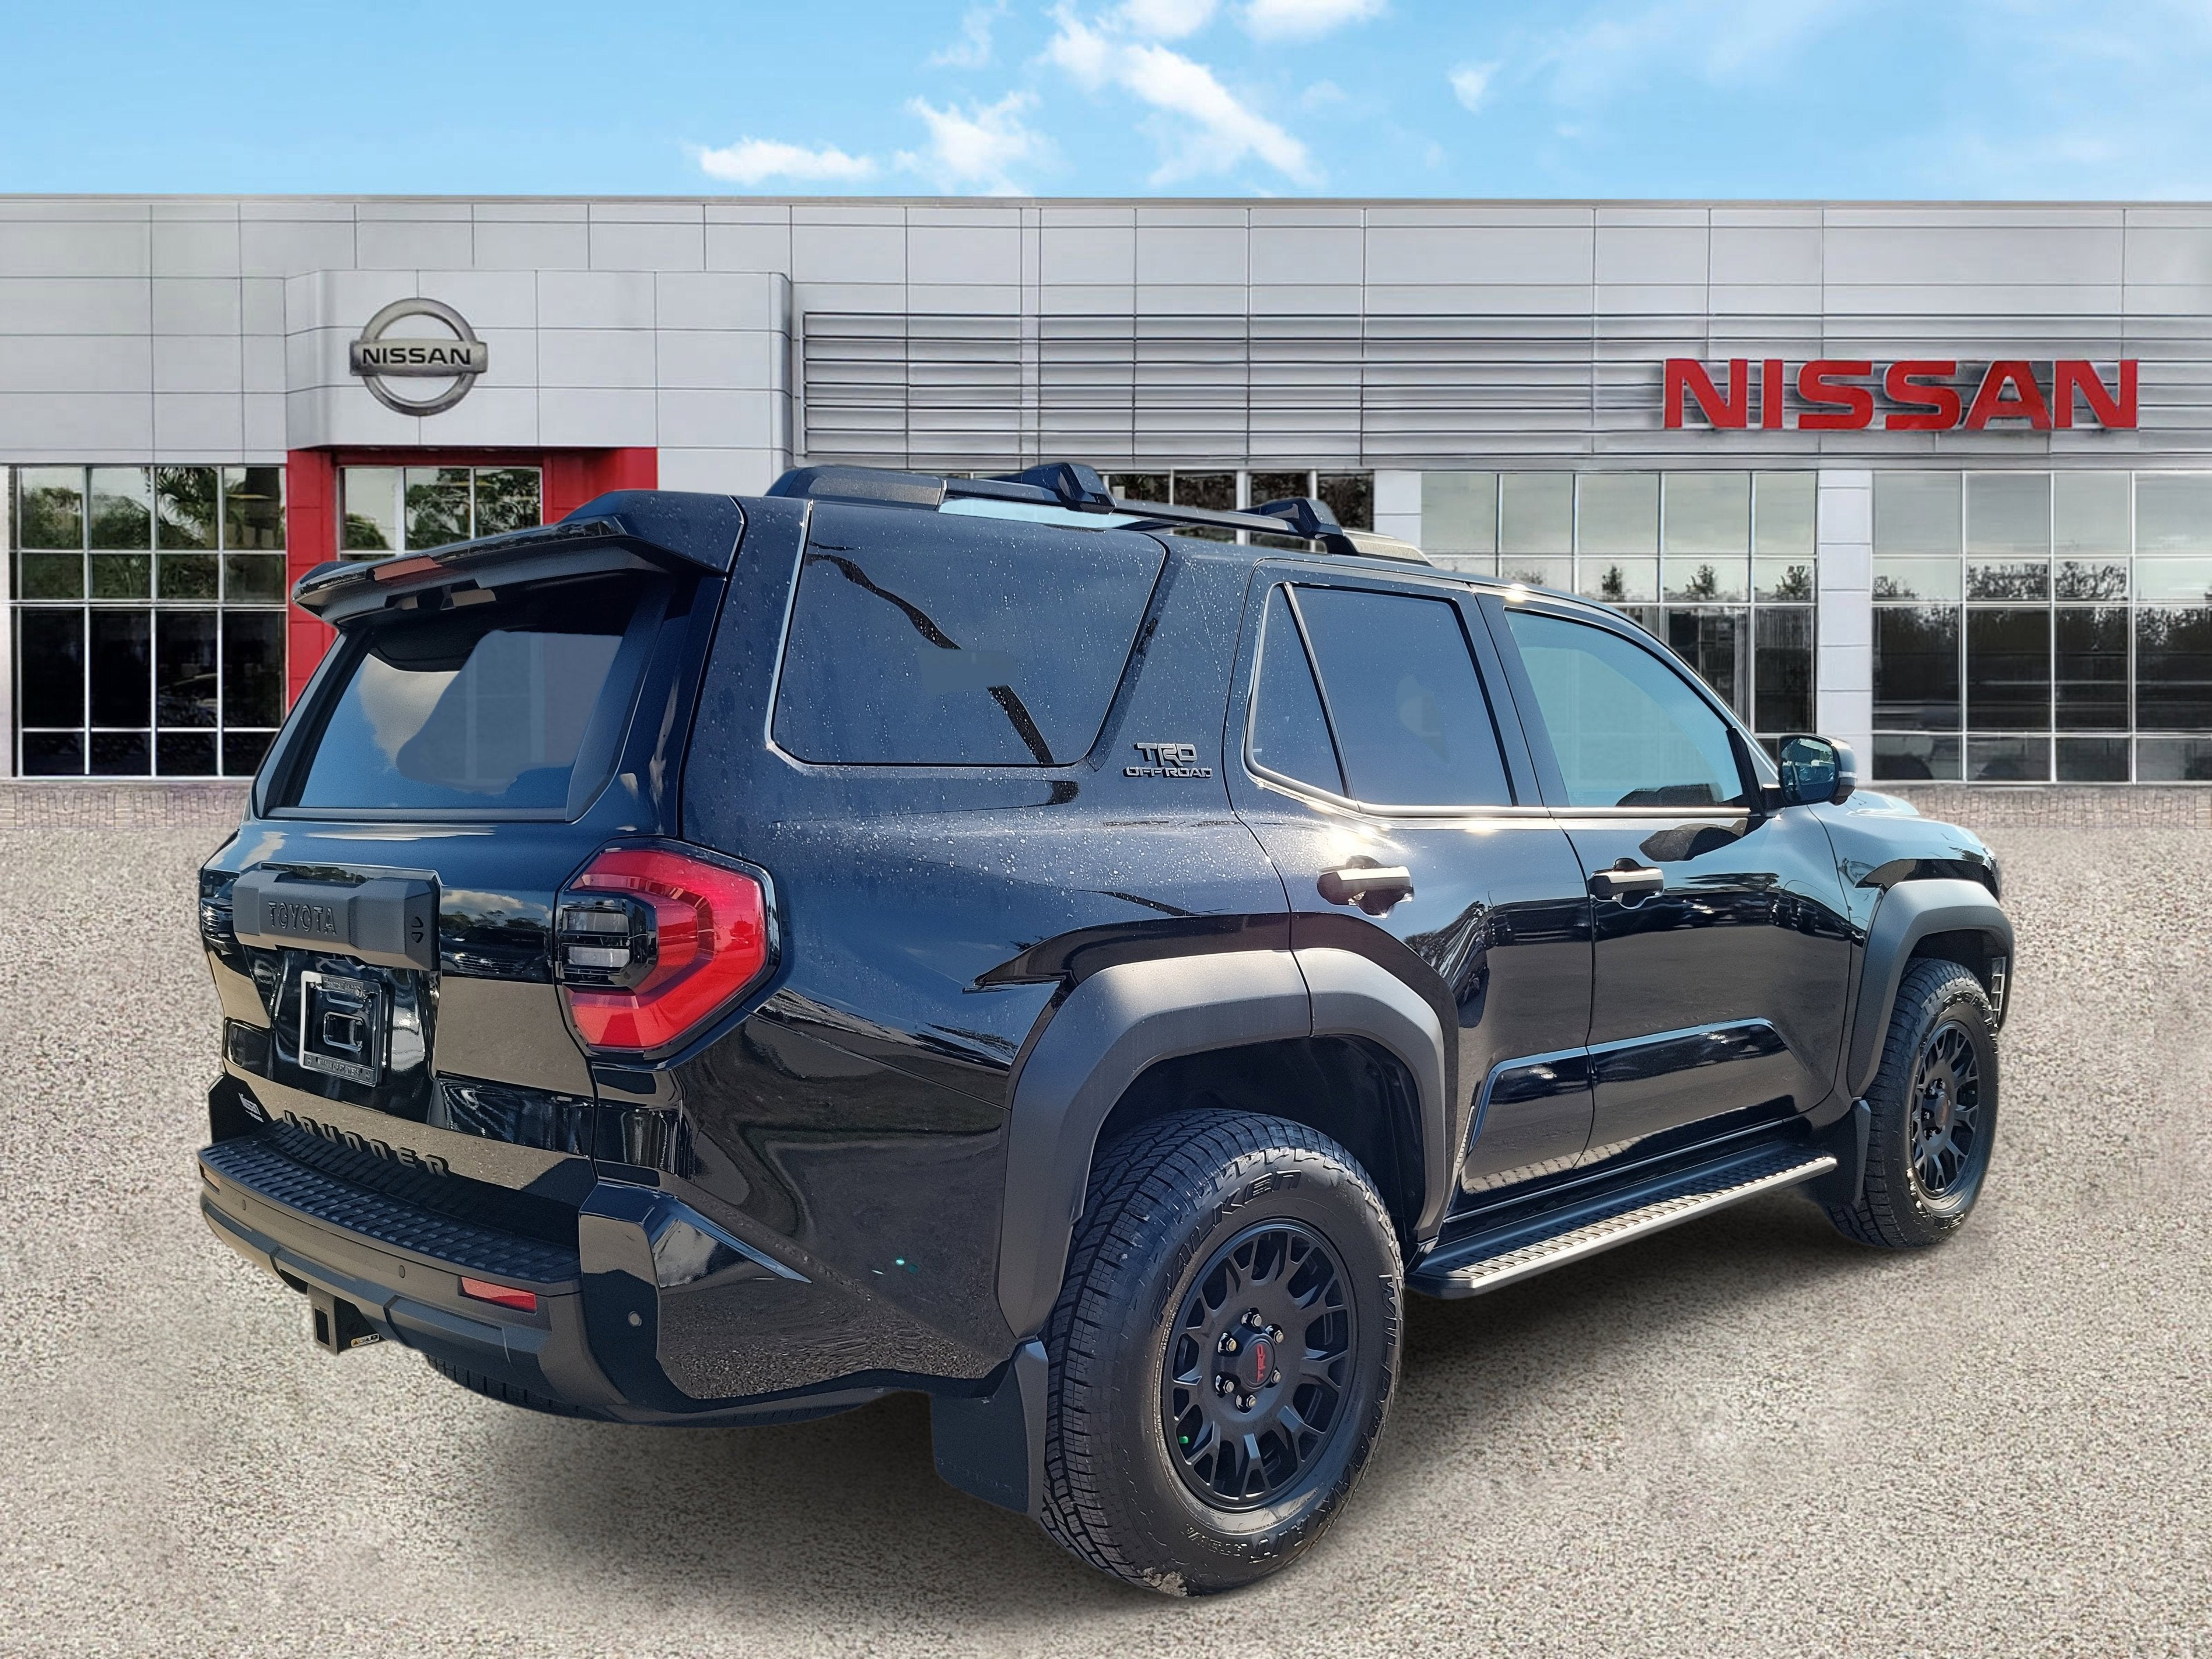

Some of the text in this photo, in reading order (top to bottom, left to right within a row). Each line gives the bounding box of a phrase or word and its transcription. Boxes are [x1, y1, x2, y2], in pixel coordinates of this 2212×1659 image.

[362, 348, 471, 365] NISSAN
[1662, 358, 2140, 431] NISSAN
[1136, 743, 1198, 766] TRD
[268, 901, 337, 936] TOYOTA
